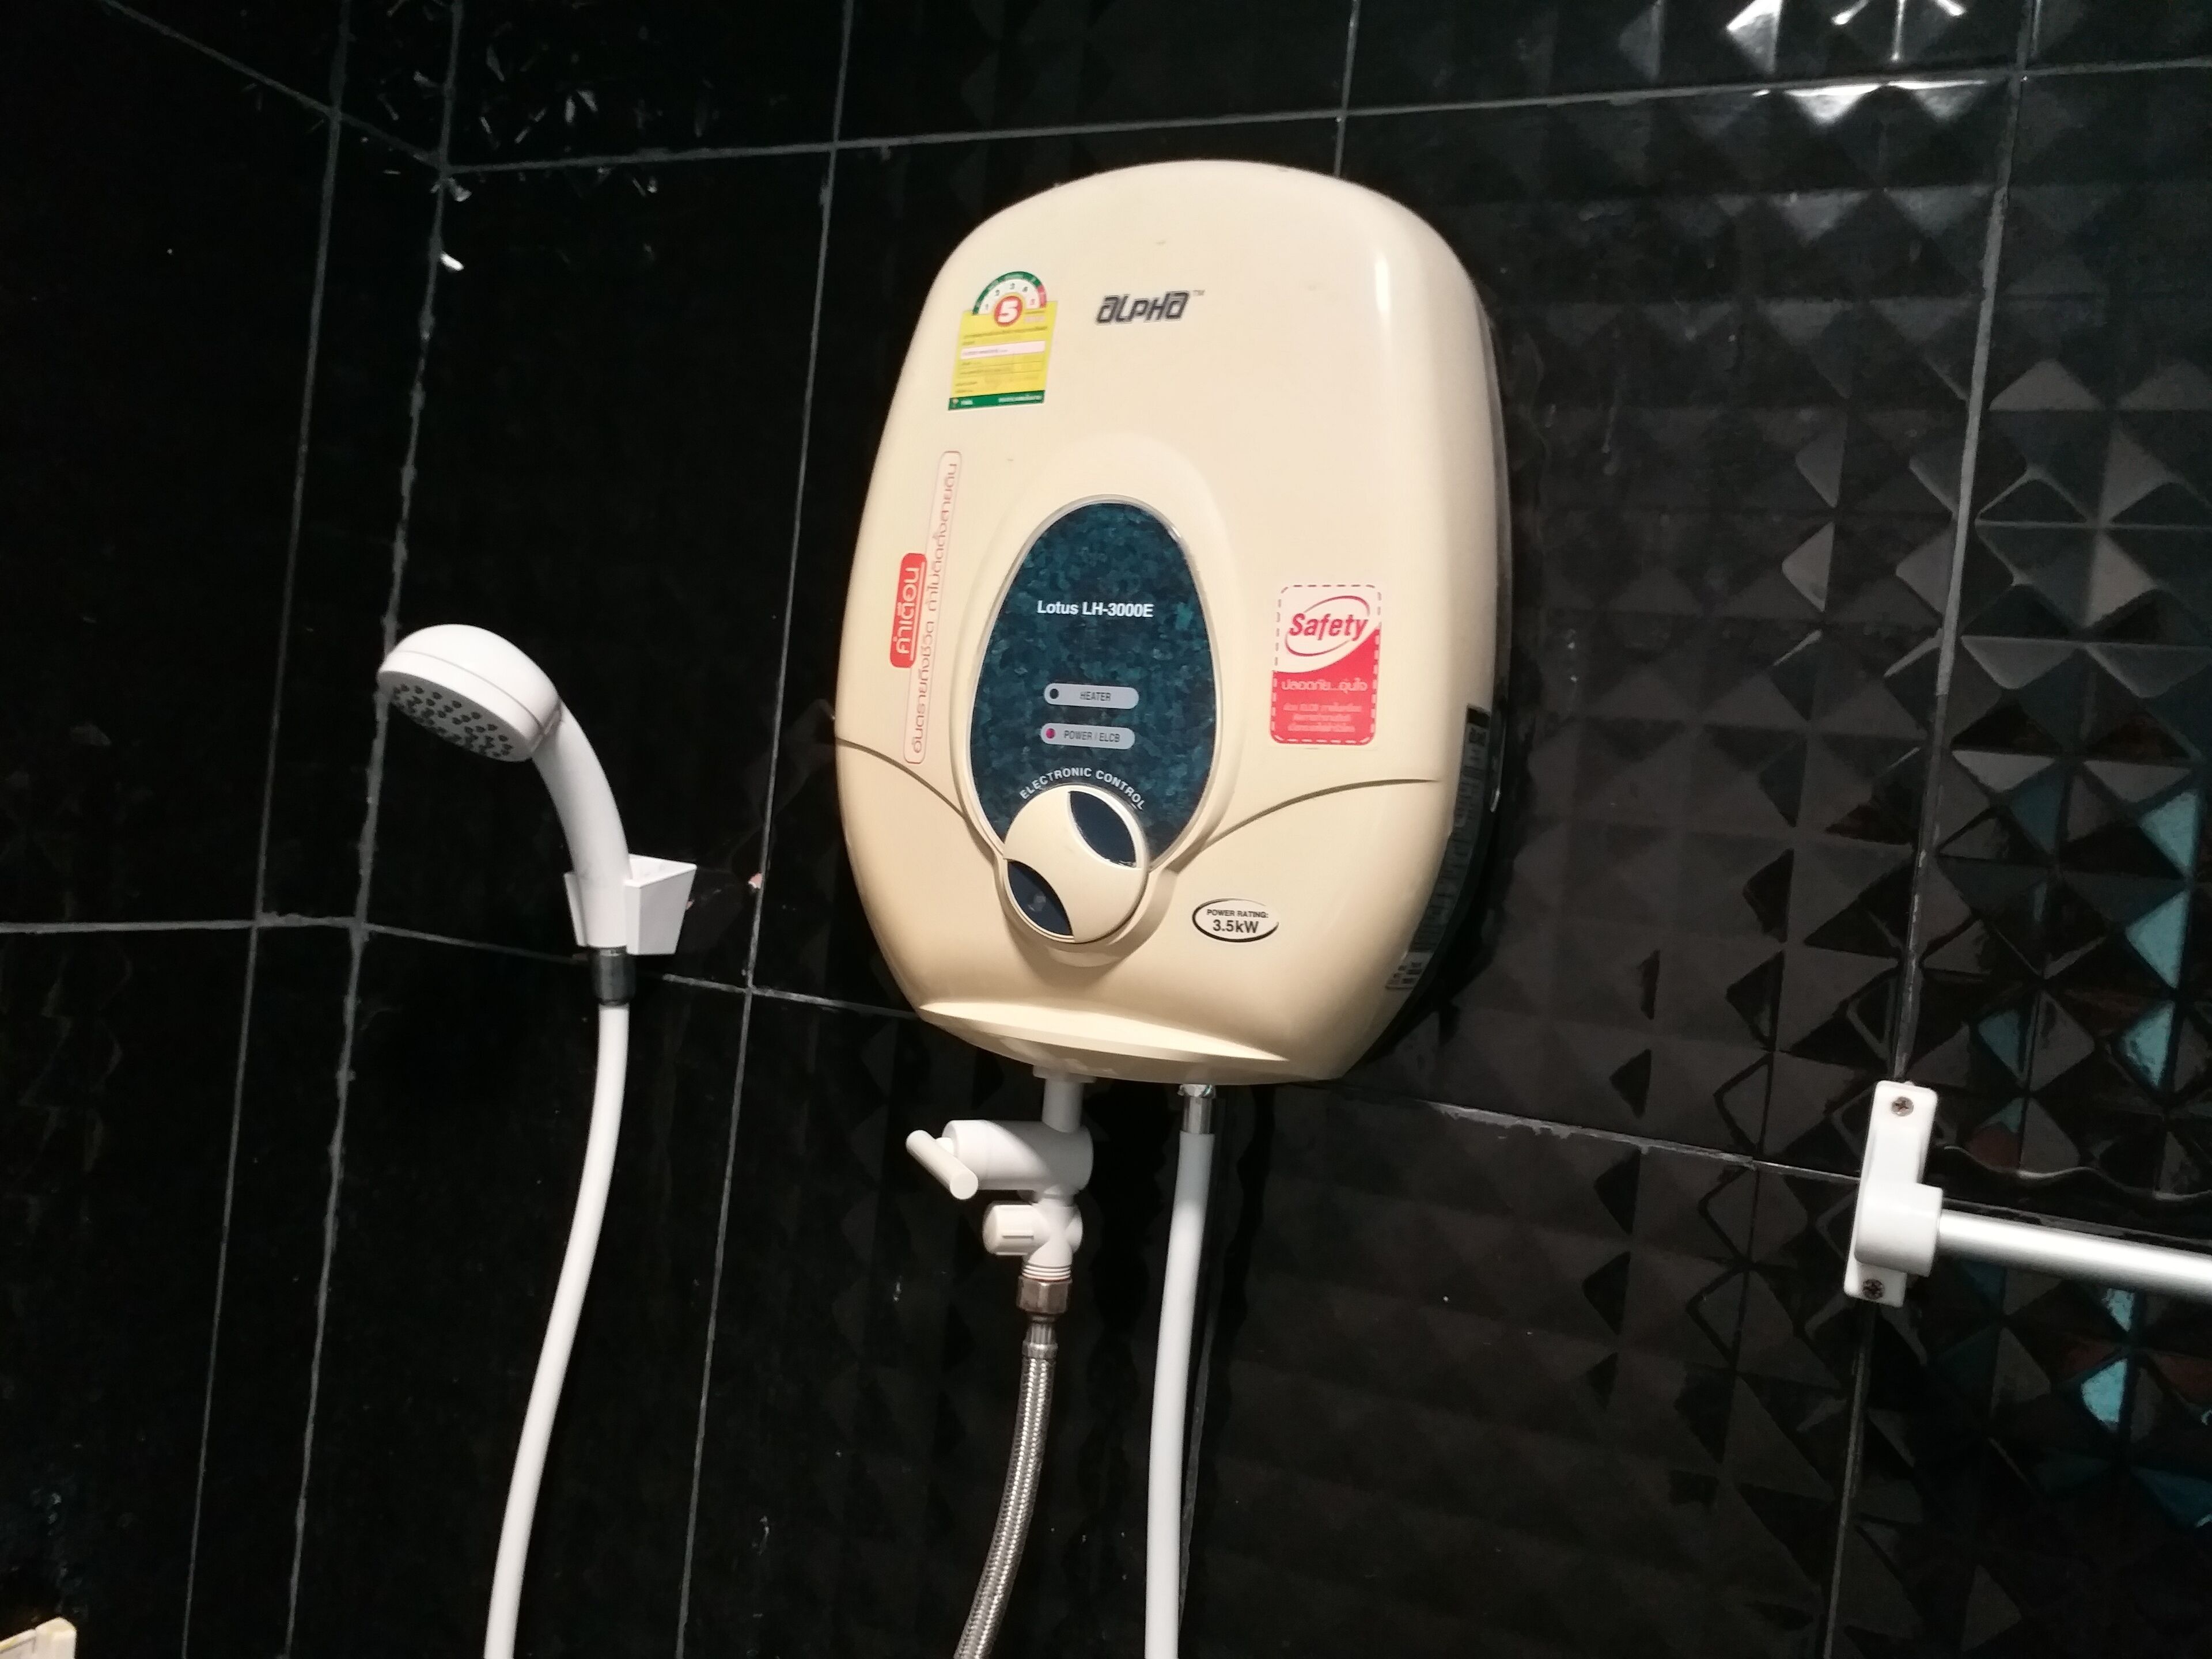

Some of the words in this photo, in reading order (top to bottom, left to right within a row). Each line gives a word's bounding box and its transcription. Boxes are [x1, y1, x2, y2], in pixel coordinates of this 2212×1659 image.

[997, 300, 1018, 323] 5
[893, 566, 920, 653] คำเตือน
[1037, 600, 1078, 615] Lotus
[1082, 602, 1154, 618] LH-3000E
[1289, 613, 1369, 641] Safety
[1080, 691, 1111, 701] HEATER
[1064, 730, 1092, 740] POWER
[1099, 732, 1120, 743] ELCB
[1020, 767, 1092, 800] ELECTRONIC
[1095, 770, 1145, 810] CONTROL
[1213, 919, 1259, 933] 3.5kW
